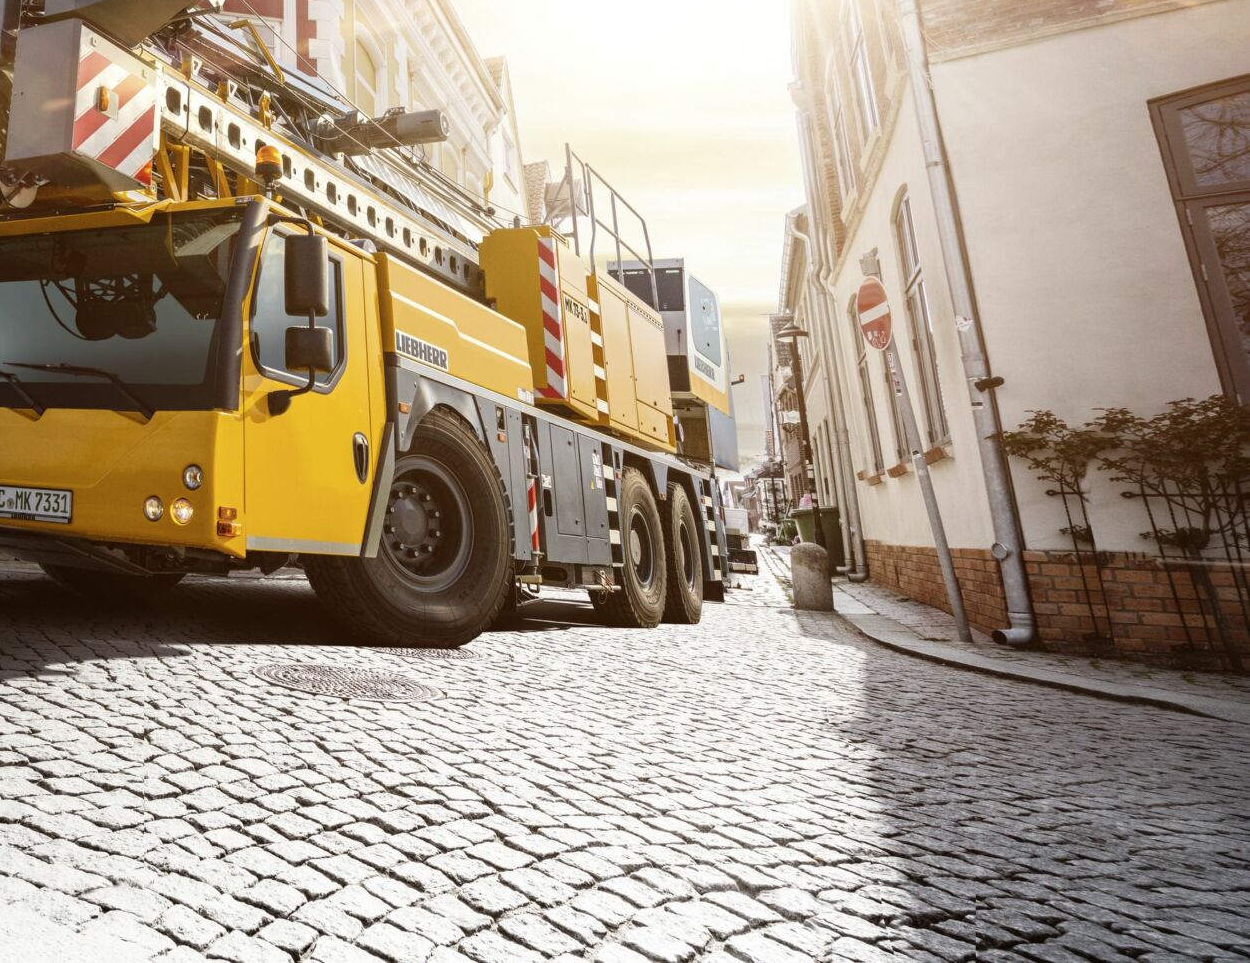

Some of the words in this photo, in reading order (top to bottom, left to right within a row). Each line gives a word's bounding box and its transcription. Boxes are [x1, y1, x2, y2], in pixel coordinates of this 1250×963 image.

[395, 331, 448, 370] LIEBHERR
[15, 490, 32, 511] MK
[35, 492, 68, 513] 7331
